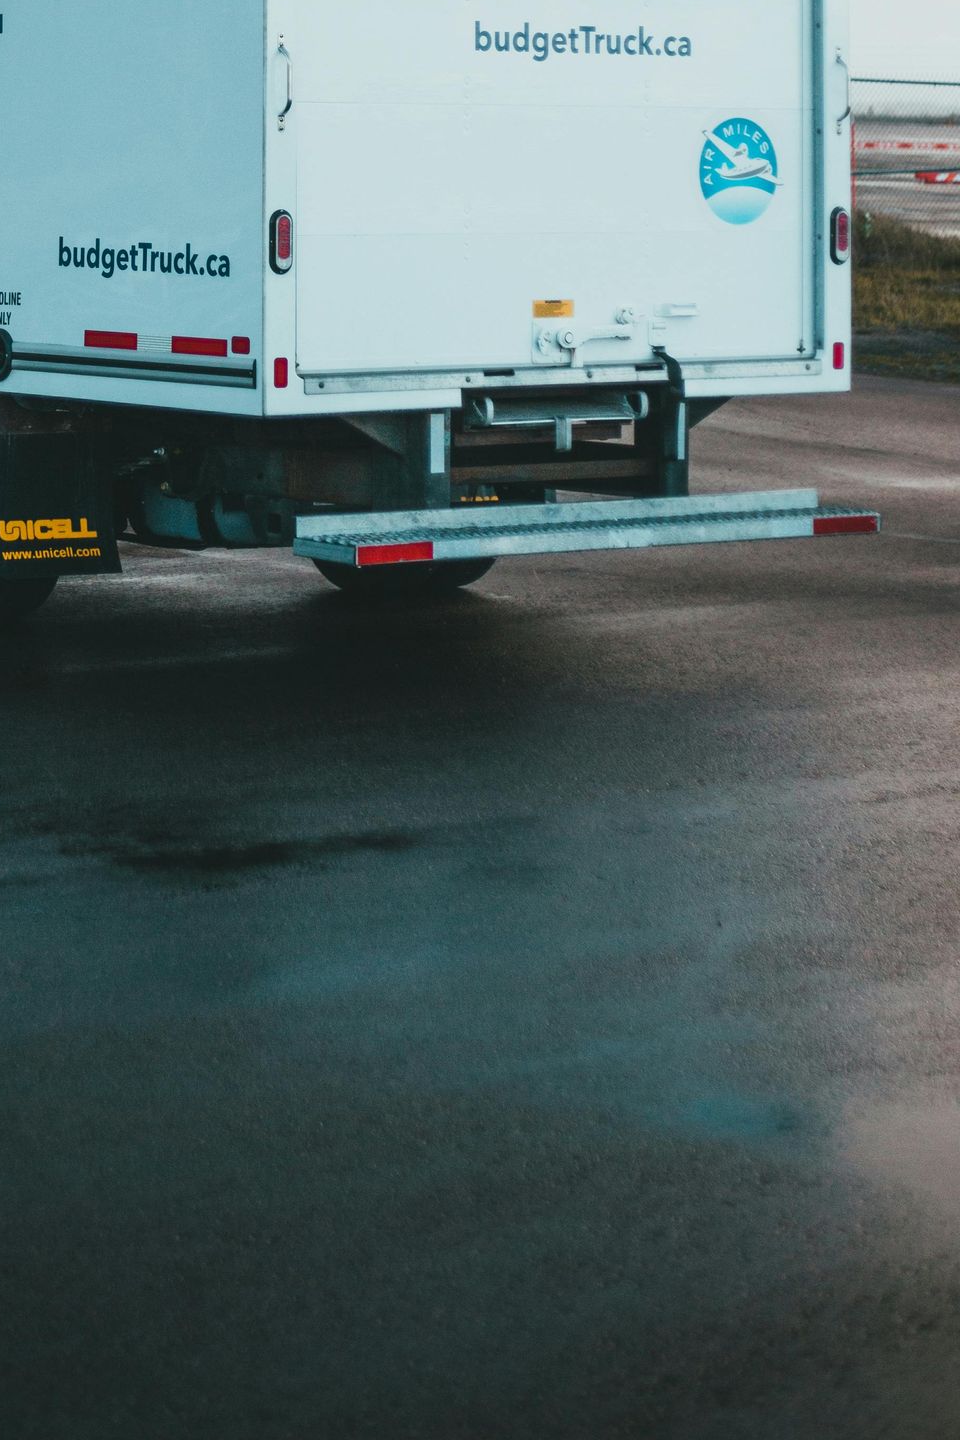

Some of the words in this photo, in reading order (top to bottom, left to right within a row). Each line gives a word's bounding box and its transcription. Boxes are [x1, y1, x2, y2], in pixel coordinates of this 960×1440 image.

[474, 20, 692, 62] budgetTruck.ca
[703, 147, 716, 186] AIR
[722, 123, 770, 155] MILES
[58, 236, 231, 279] budgetTruck.ca
[2, 546, 101, 561] www.unicell.com
